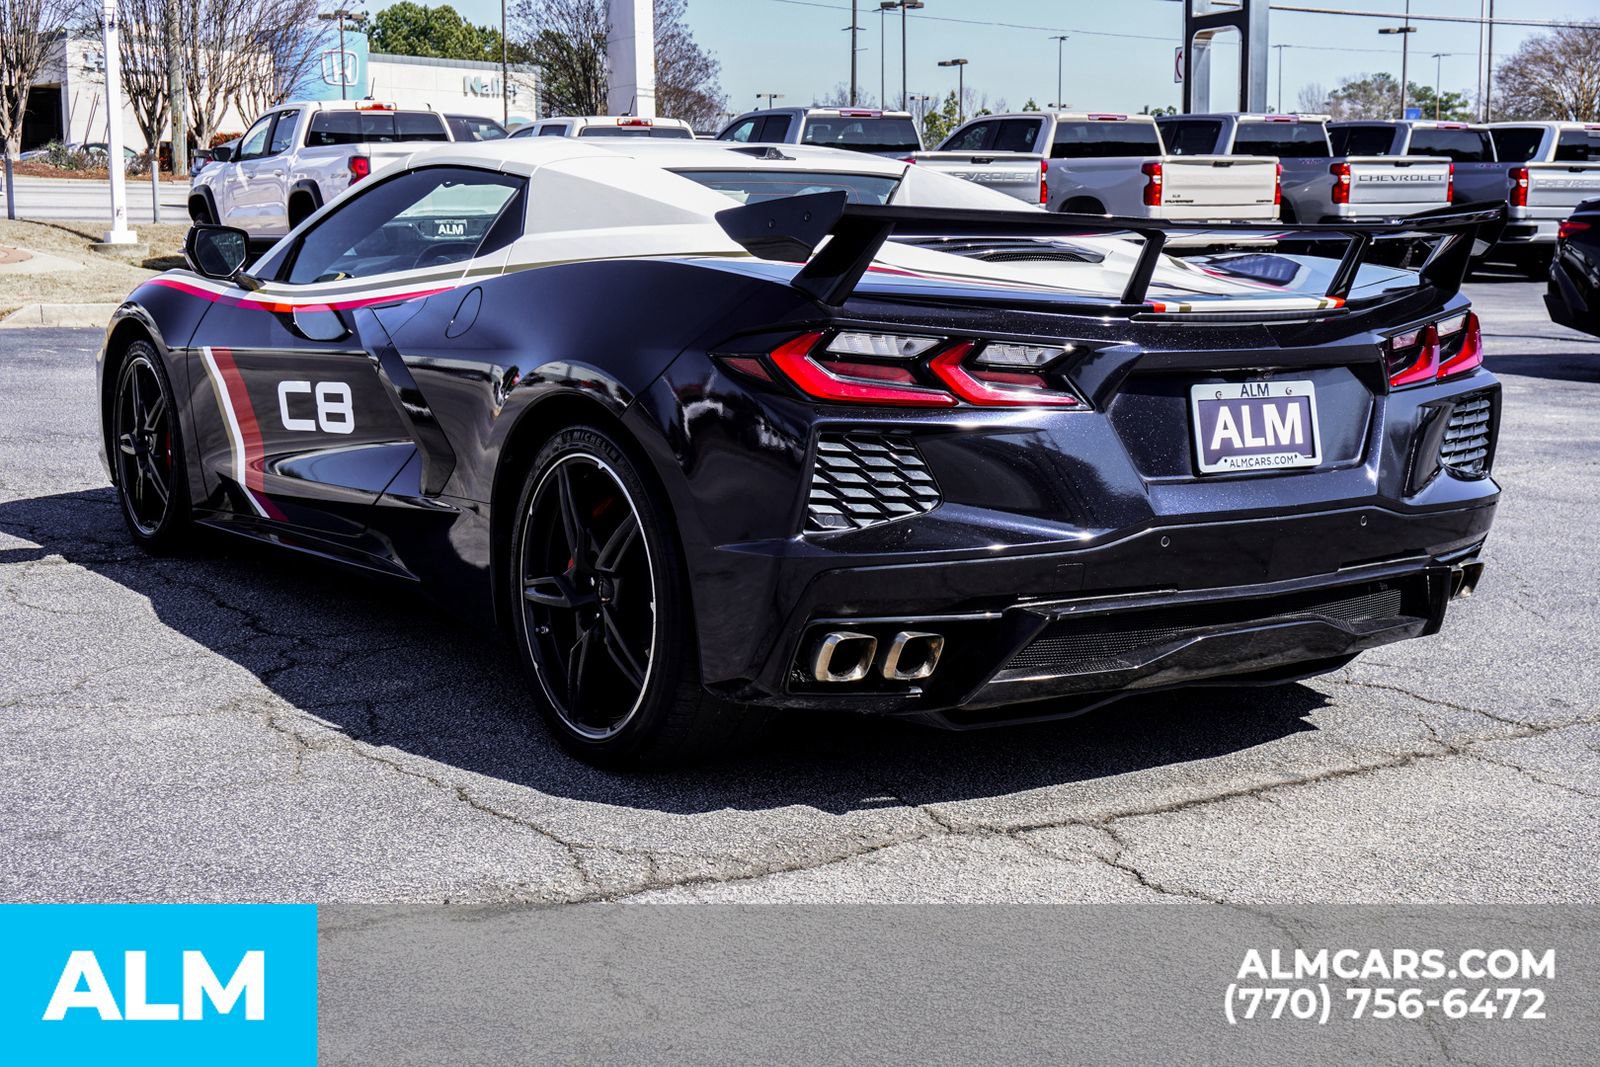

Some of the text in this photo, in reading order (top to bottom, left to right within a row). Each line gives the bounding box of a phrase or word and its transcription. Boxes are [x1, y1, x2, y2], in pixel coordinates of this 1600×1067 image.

[1359, 174, 1444, 182] CHEVROLET
[438, 224, 464, 235] ALM
[1240, 383, 1270, 398] ALM
[278, 380, 355, 434] C8
[1210, 402, 1304, 450] ALM
[572, 430, 621, 463] MICHELIN
[1229, 455, 1294, 469] ALMCARS.COM
